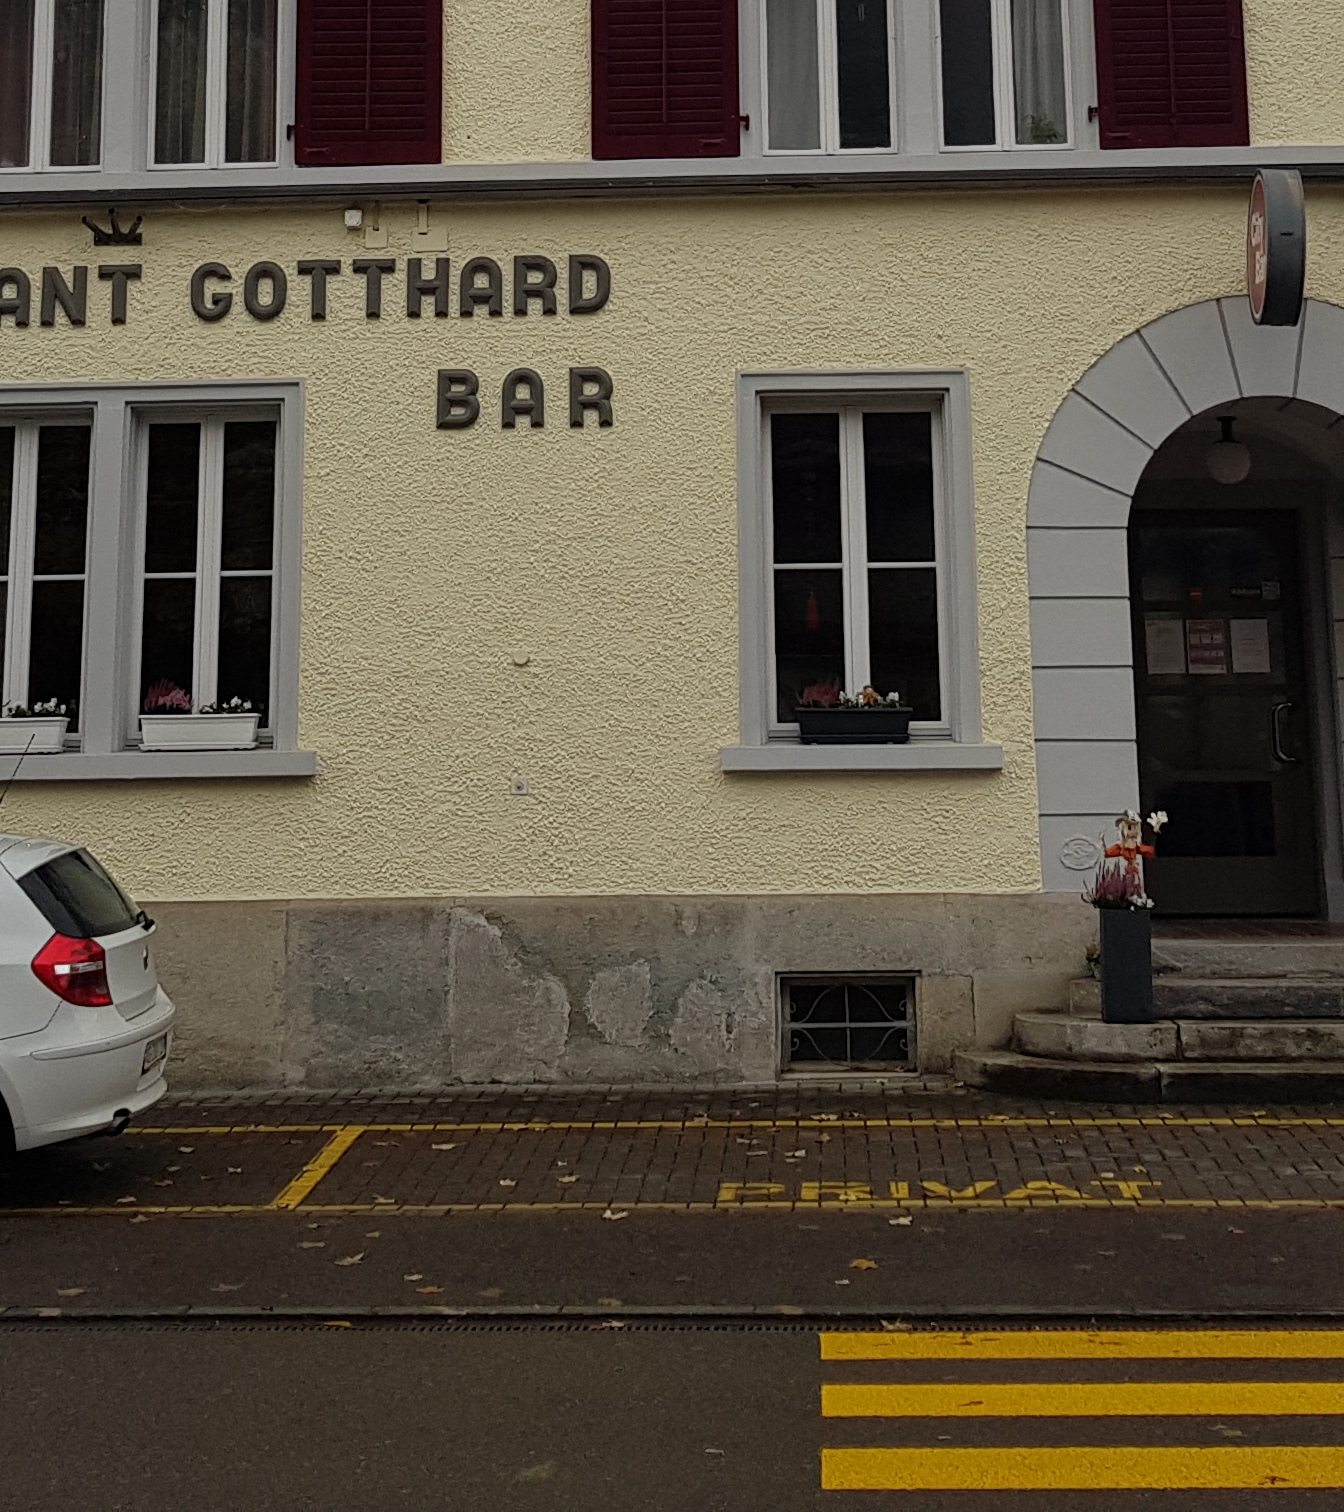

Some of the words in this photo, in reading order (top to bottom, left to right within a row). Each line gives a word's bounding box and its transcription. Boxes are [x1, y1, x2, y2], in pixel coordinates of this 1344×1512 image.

[190, 254, 611, 321] GOTTHARD
[436, 367, 615, 430] BAR
[717, 1179, 1162, 1201] PRIVAT
